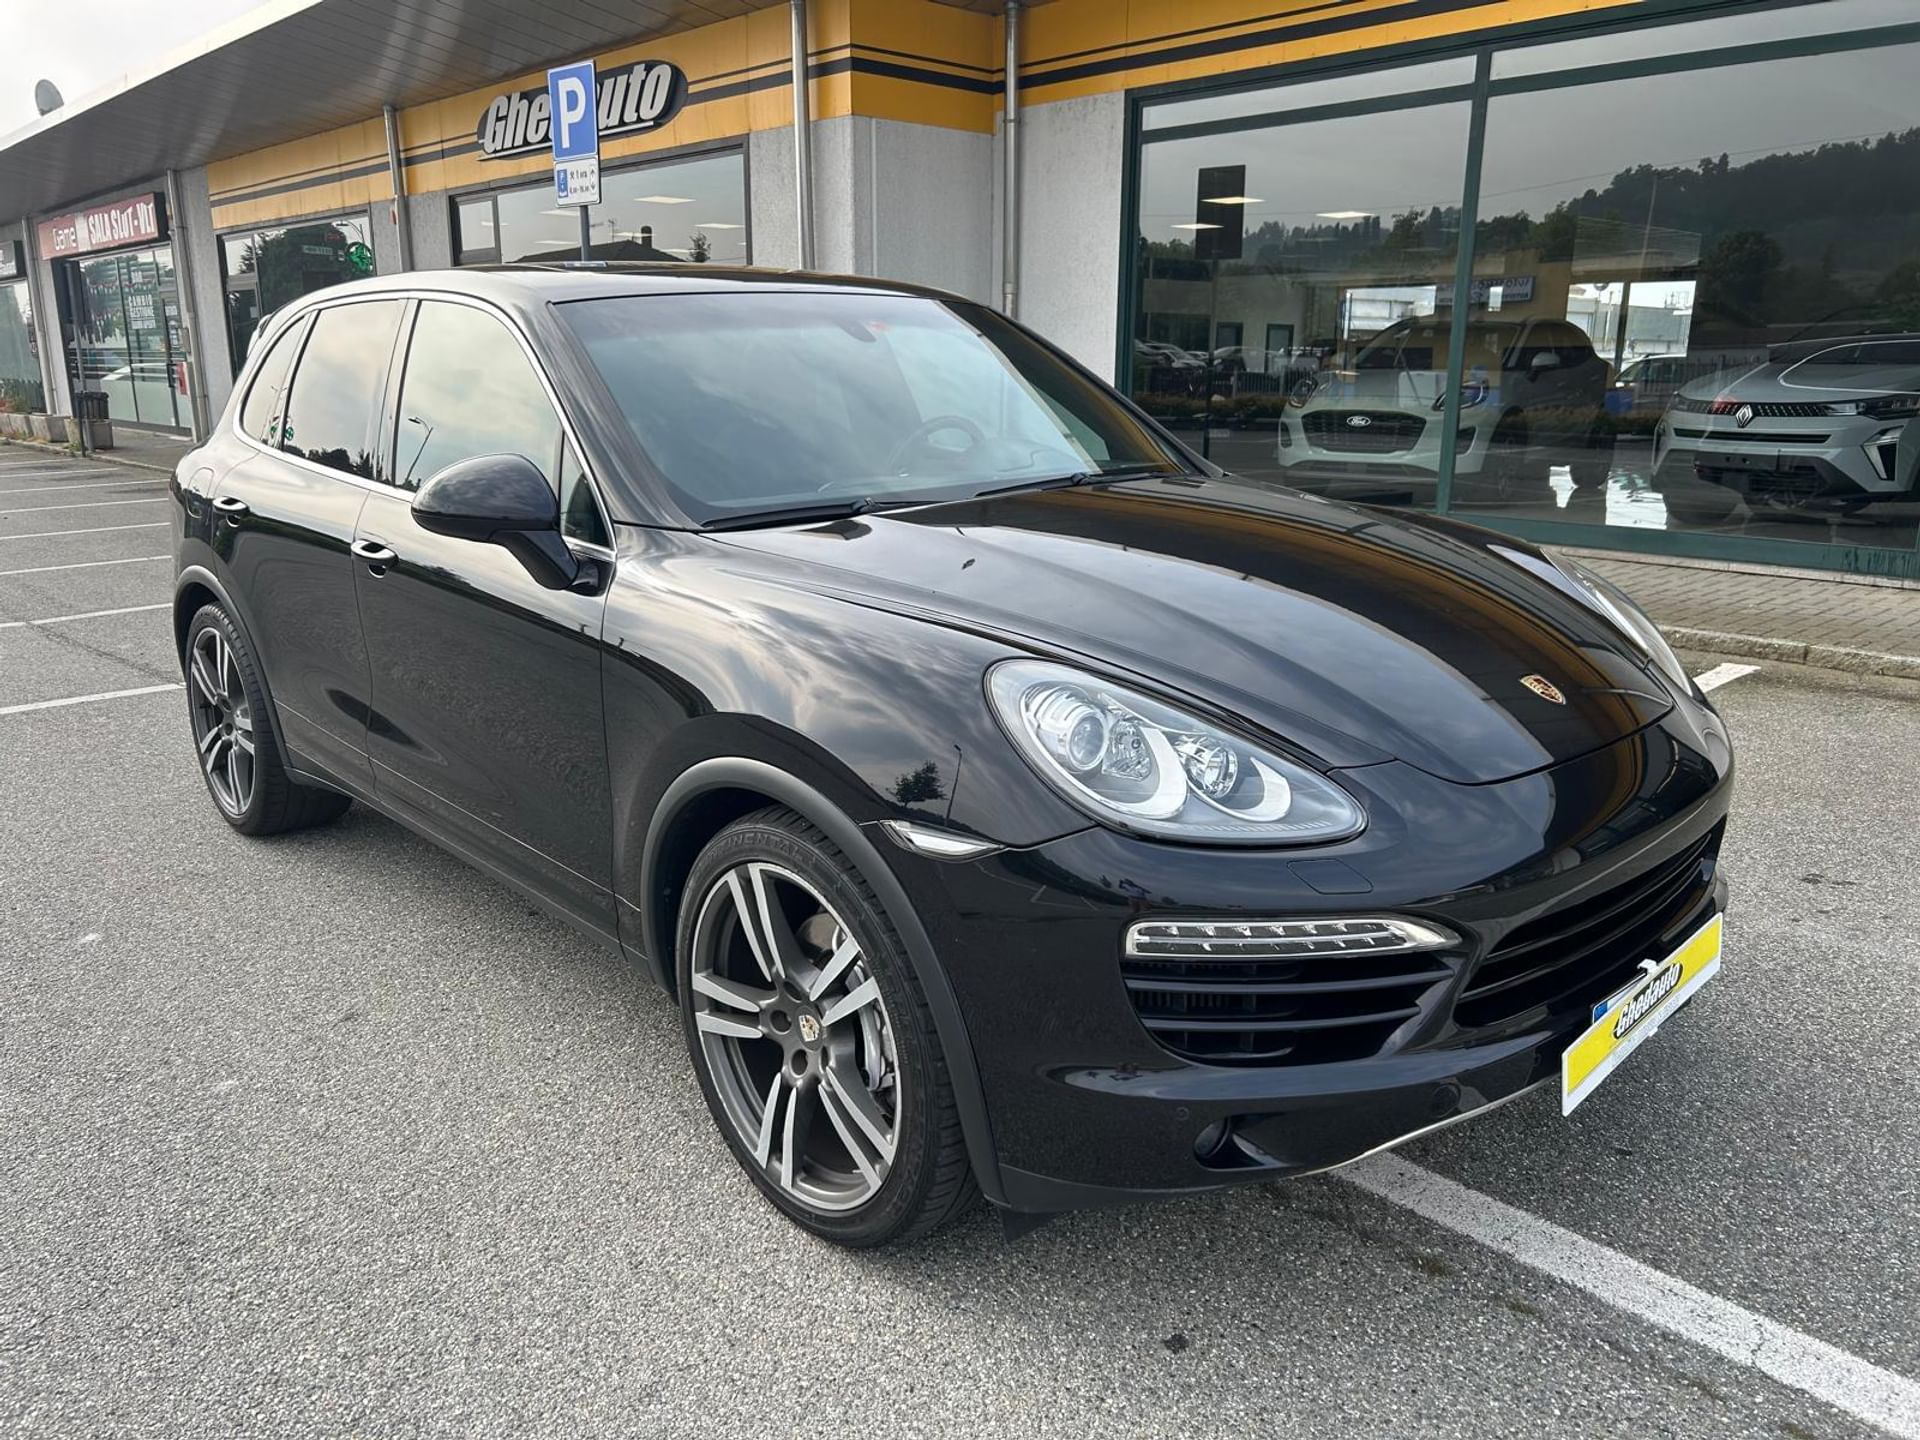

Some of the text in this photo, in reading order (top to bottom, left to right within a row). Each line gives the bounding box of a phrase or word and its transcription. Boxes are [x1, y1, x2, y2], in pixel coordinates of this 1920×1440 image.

[557, 76, 586, 149] P
[88, 213, 112, 245] SALA
[1616, 963, 1681, 1037] Ghedauto
